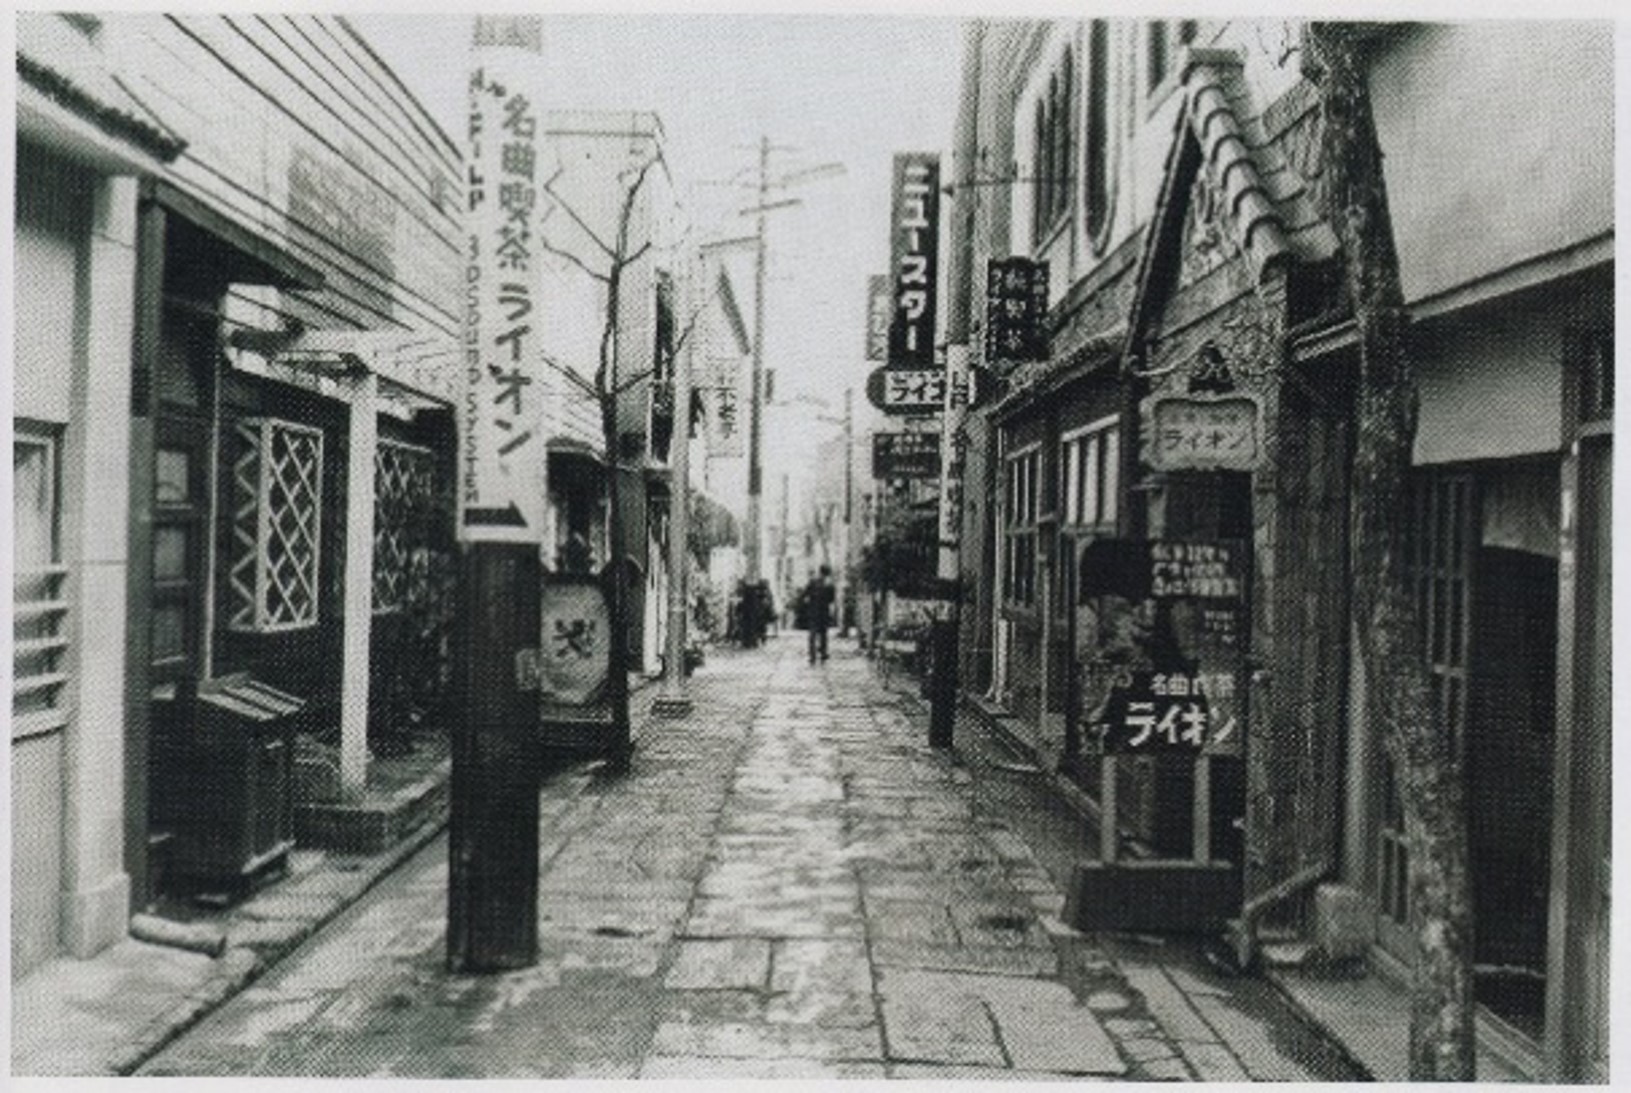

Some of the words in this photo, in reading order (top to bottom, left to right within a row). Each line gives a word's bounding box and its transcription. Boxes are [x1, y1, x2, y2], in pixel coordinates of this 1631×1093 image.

[1164, 429, 1248, 451] ライオン
[1125, 701, 1238, 747] ライオン
